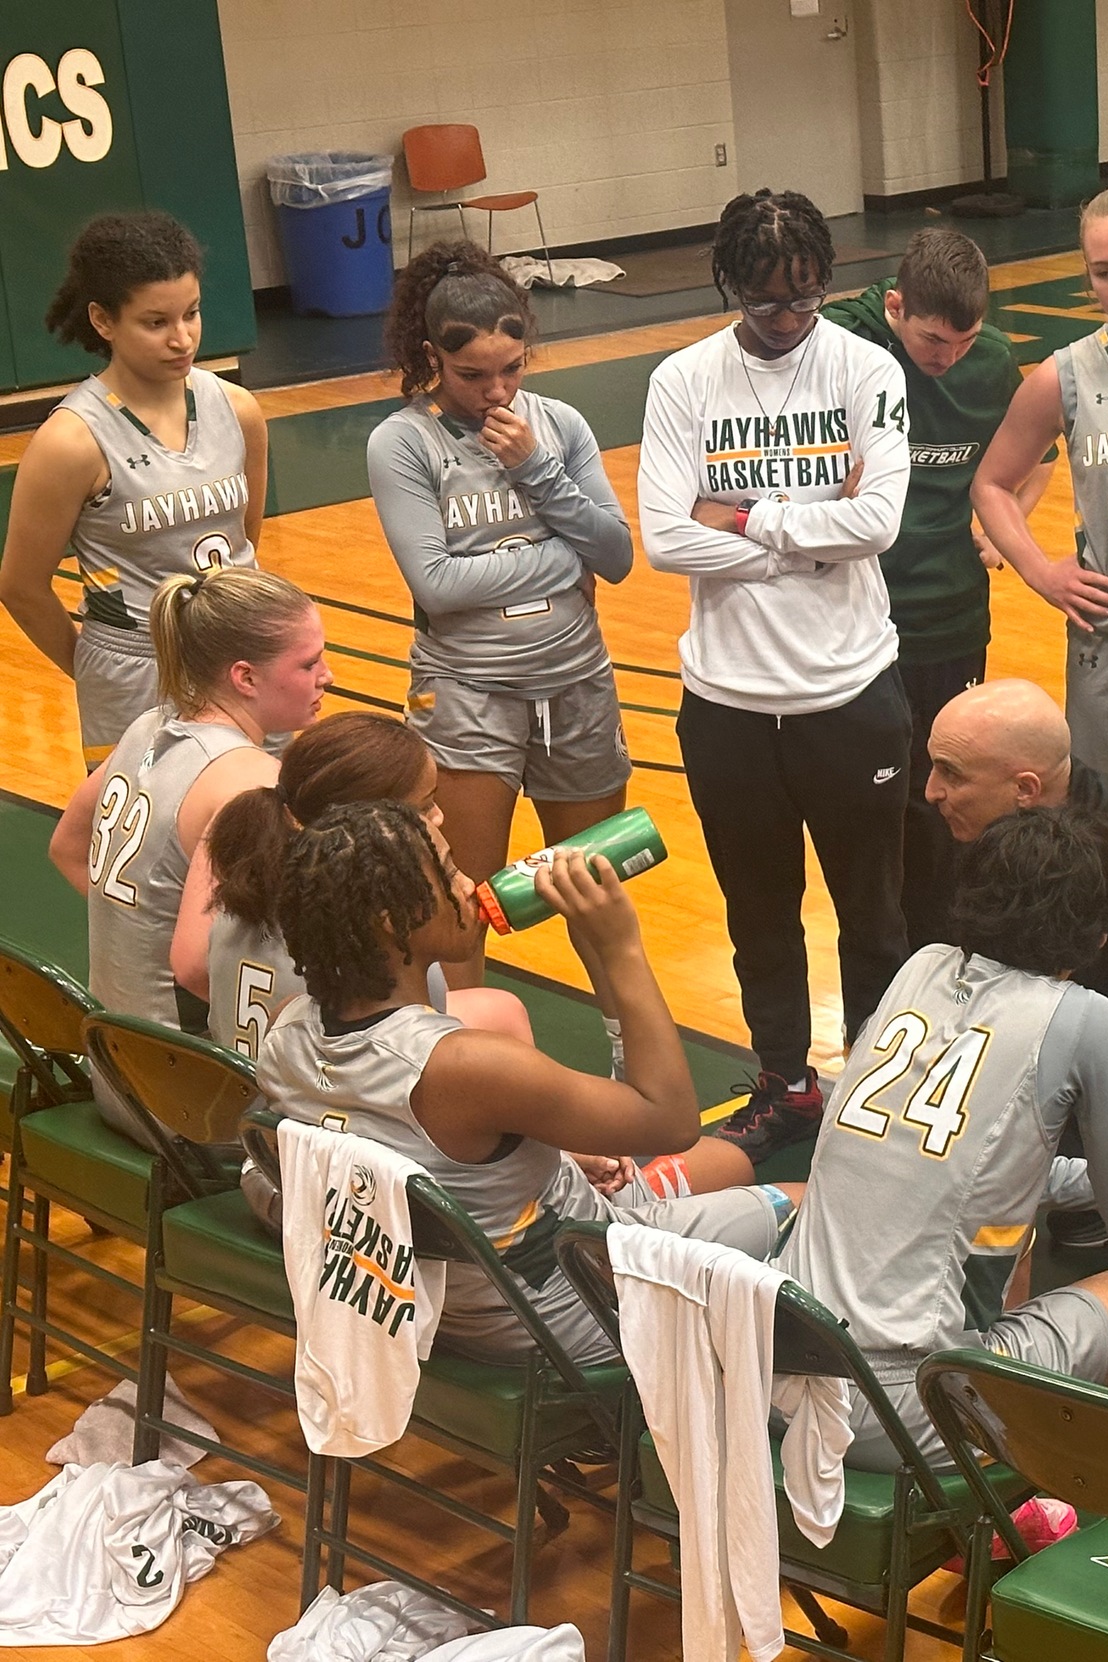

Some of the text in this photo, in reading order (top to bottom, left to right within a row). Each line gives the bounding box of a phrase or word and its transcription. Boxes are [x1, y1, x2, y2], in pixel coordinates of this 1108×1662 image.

[0, 48, 113, 170] CS
[706, 408, 850, 453] JAYHAWKS
[872, 390, 905, 434] 14
[909, 446, 972, 464] KETBALL
[446, 486, 536, 530] AYHA
[877, 766, 895, 778] NIKE
[89, 772, 152, 908] 32
[235, 958, 276, 1063] 5
[835, 1008, 993, 1162] 24
[326, 1187, 415, 1287] ASKET
[131, 1544, 164, 1588] 2
